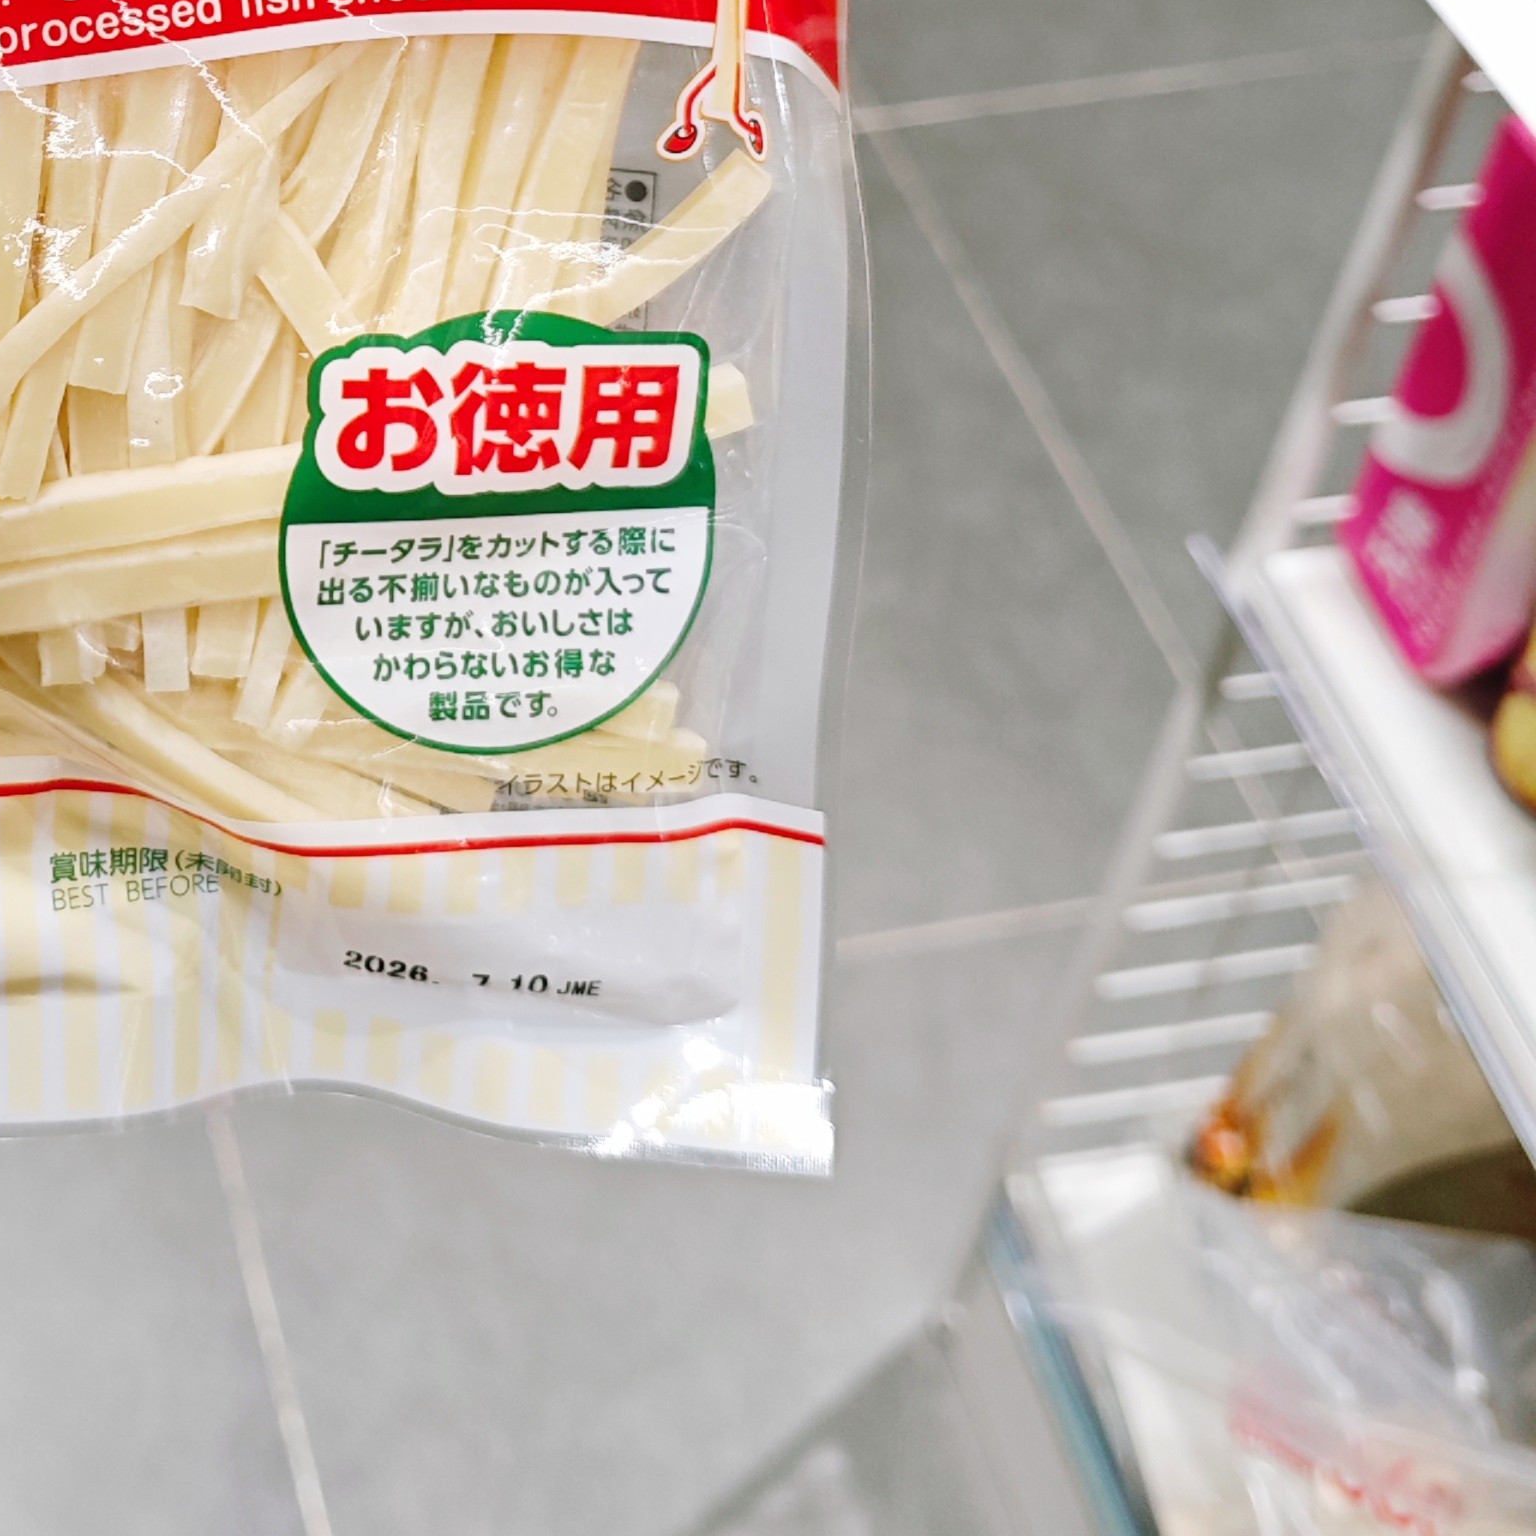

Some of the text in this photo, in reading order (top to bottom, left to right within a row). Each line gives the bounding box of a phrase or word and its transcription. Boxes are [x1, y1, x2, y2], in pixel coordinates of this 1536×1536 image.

[336, 362, 681, 475] お徳用
[318, 525, 676, 569] 「チータラ」をカットする際に
[316, 567, 672, 606] 出る不揃いなものが入って
[355, 608, 633, 641] いますが、おいしさは
[372, 648, 616, 683] かわらないお得な
[427, 690, 559, 722] 製品です。
[51, 874, 220, 912] BEST BEFORE
